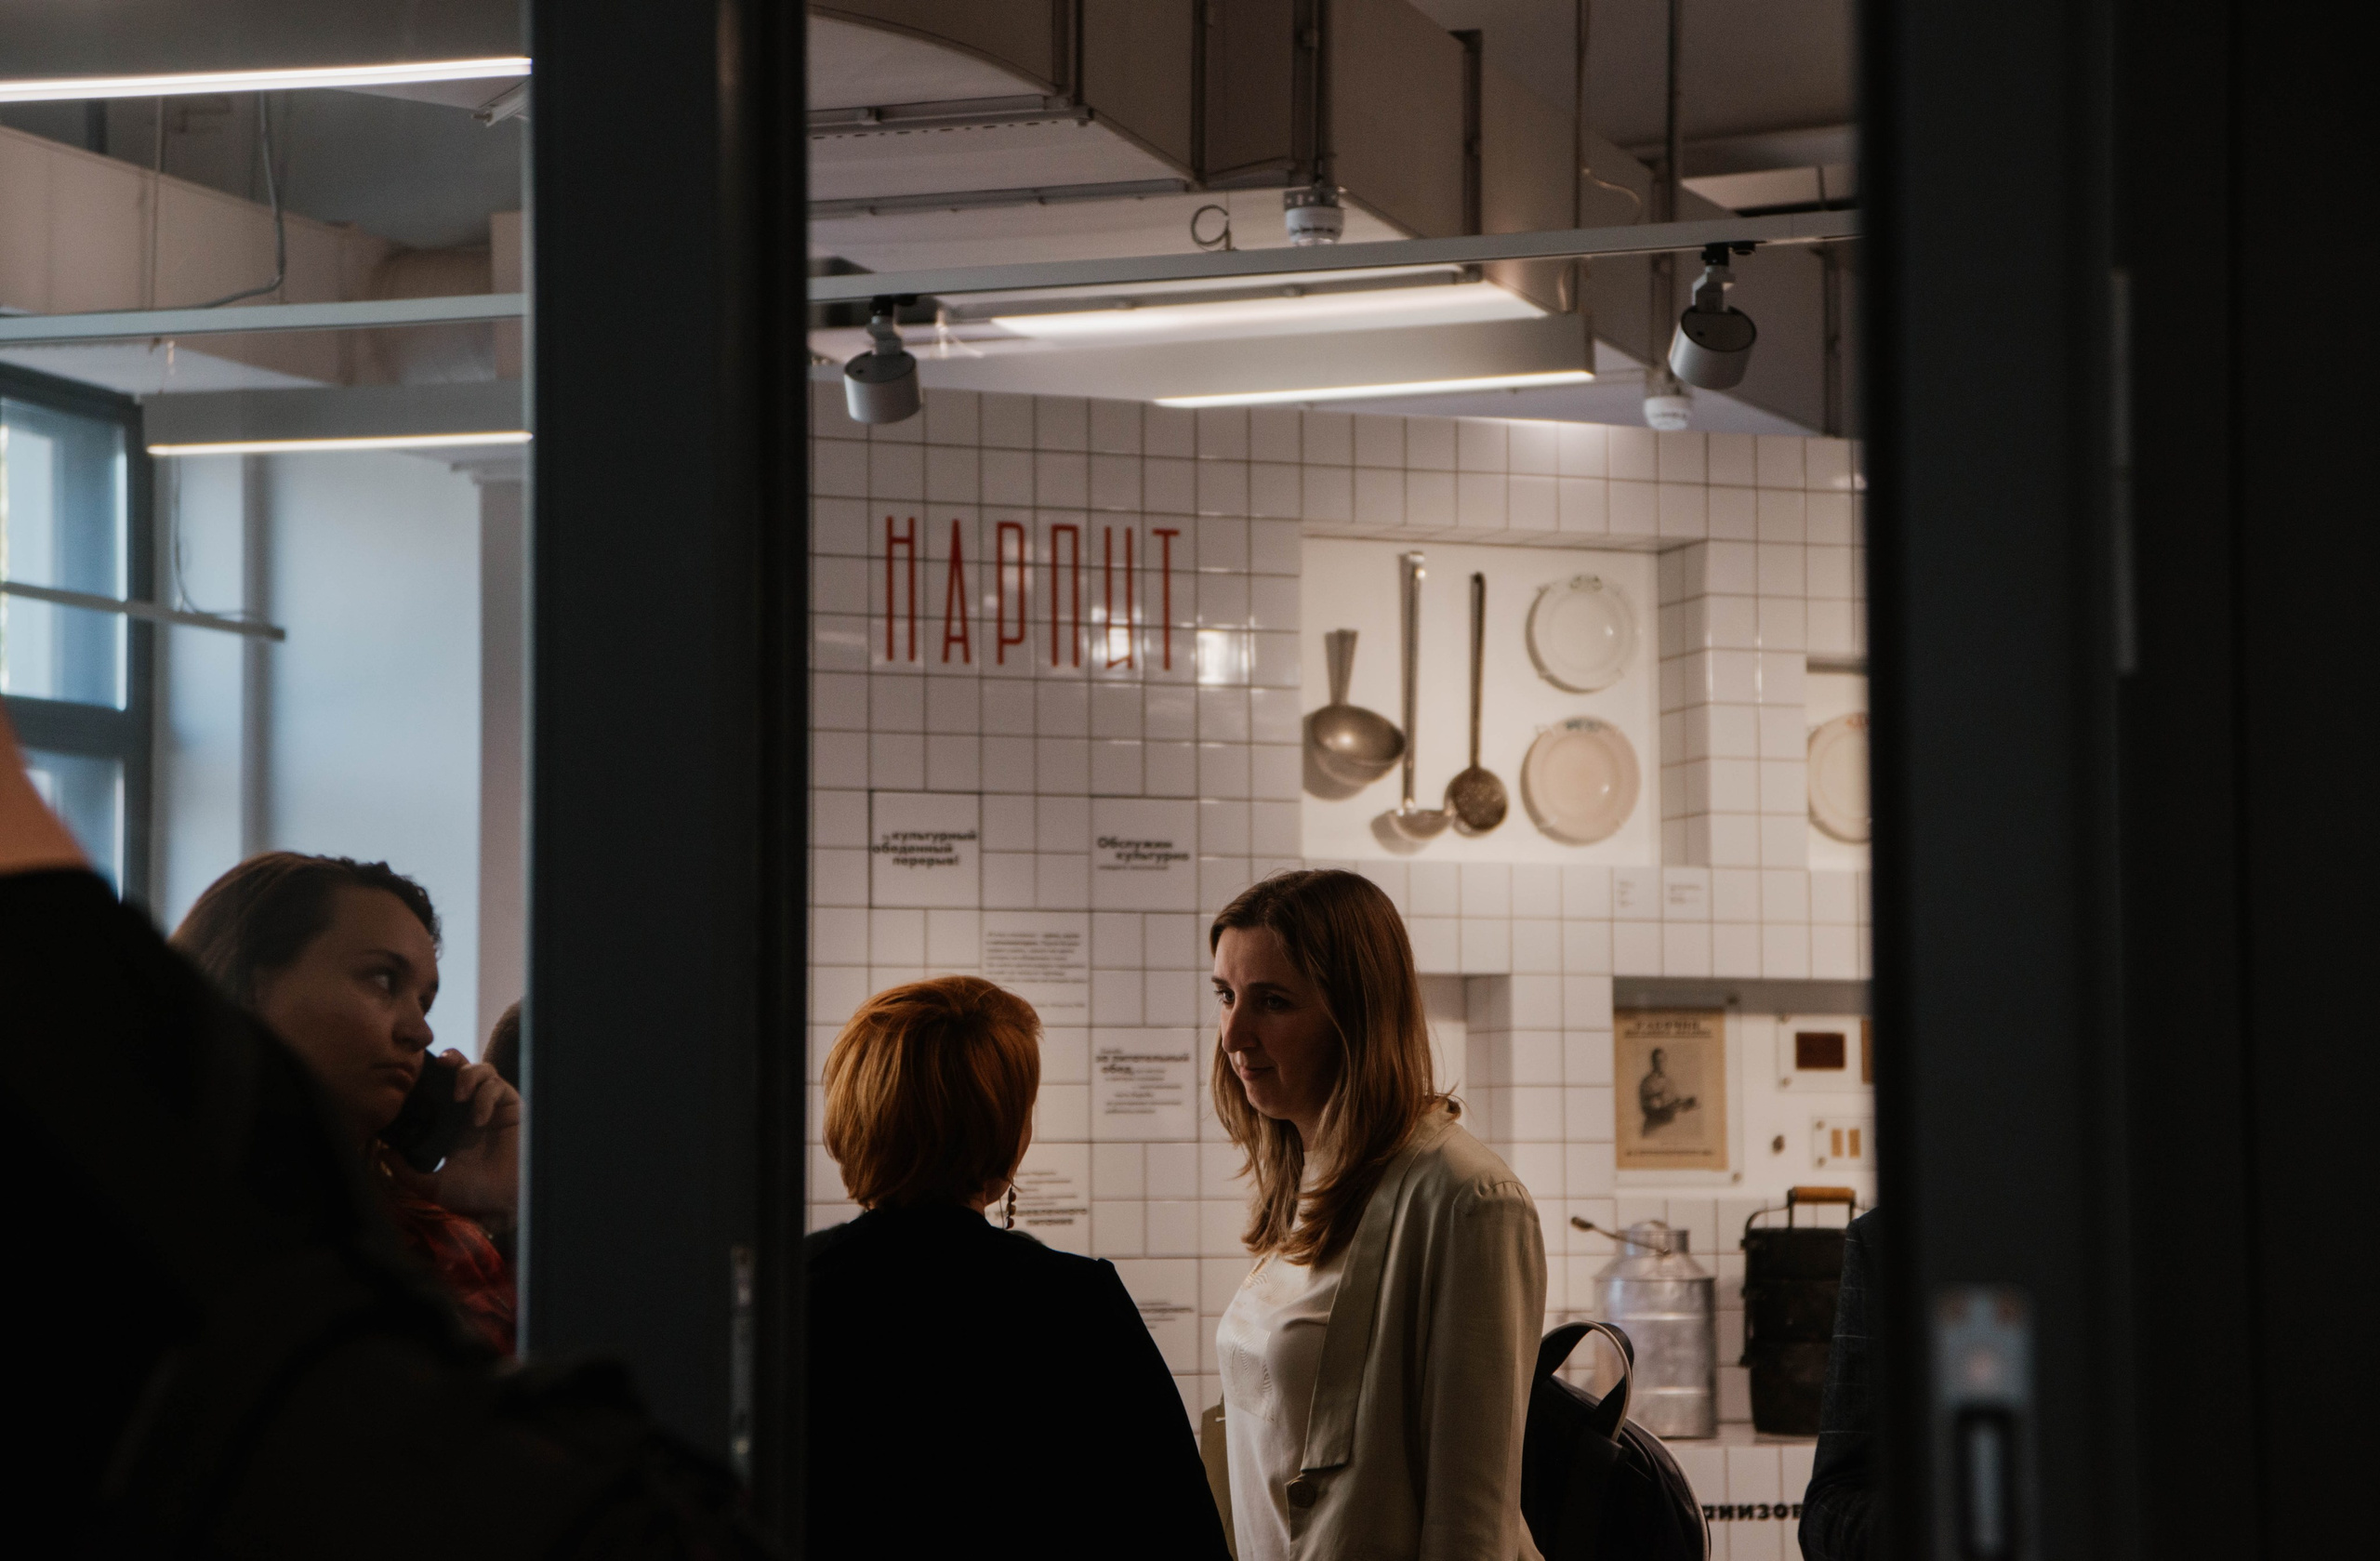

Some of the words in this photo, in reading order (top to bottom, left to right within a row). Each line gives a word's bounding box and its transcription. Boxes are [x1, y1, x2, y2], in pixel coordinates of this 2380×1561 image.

[886, 515, 1180, 670] НАРПИТ
[892, 829, 976, 843] культурный
[871, 841, 953, 854] обеденный
